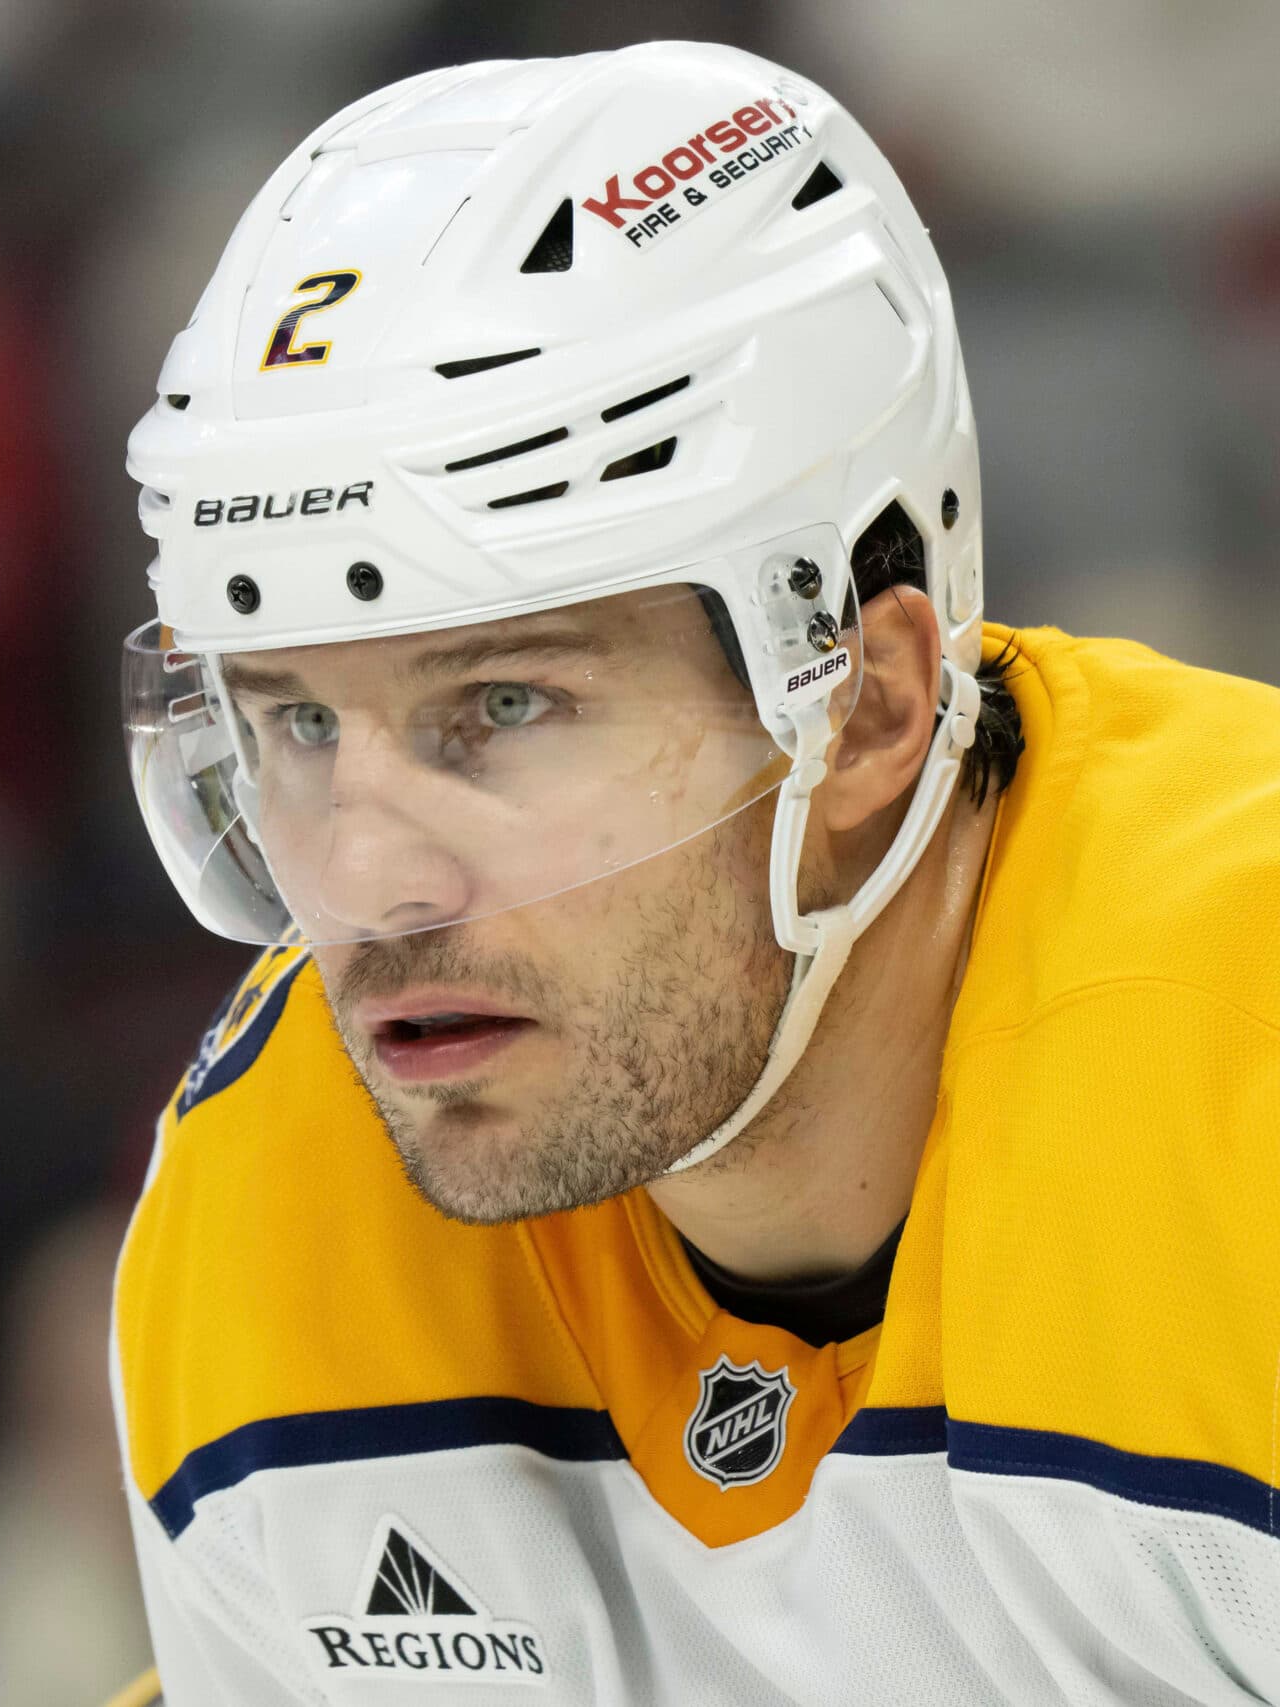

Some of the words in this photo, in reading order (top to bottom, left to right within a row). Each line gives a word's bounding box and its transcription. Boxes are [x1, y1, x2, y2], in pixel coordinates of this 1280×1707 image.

[625, 203, 681, 248] FIRE
[682, 187, 708, 207] &
[259, 268, 363, 372] 2
[705, 1399, 773, 1456] NHL
